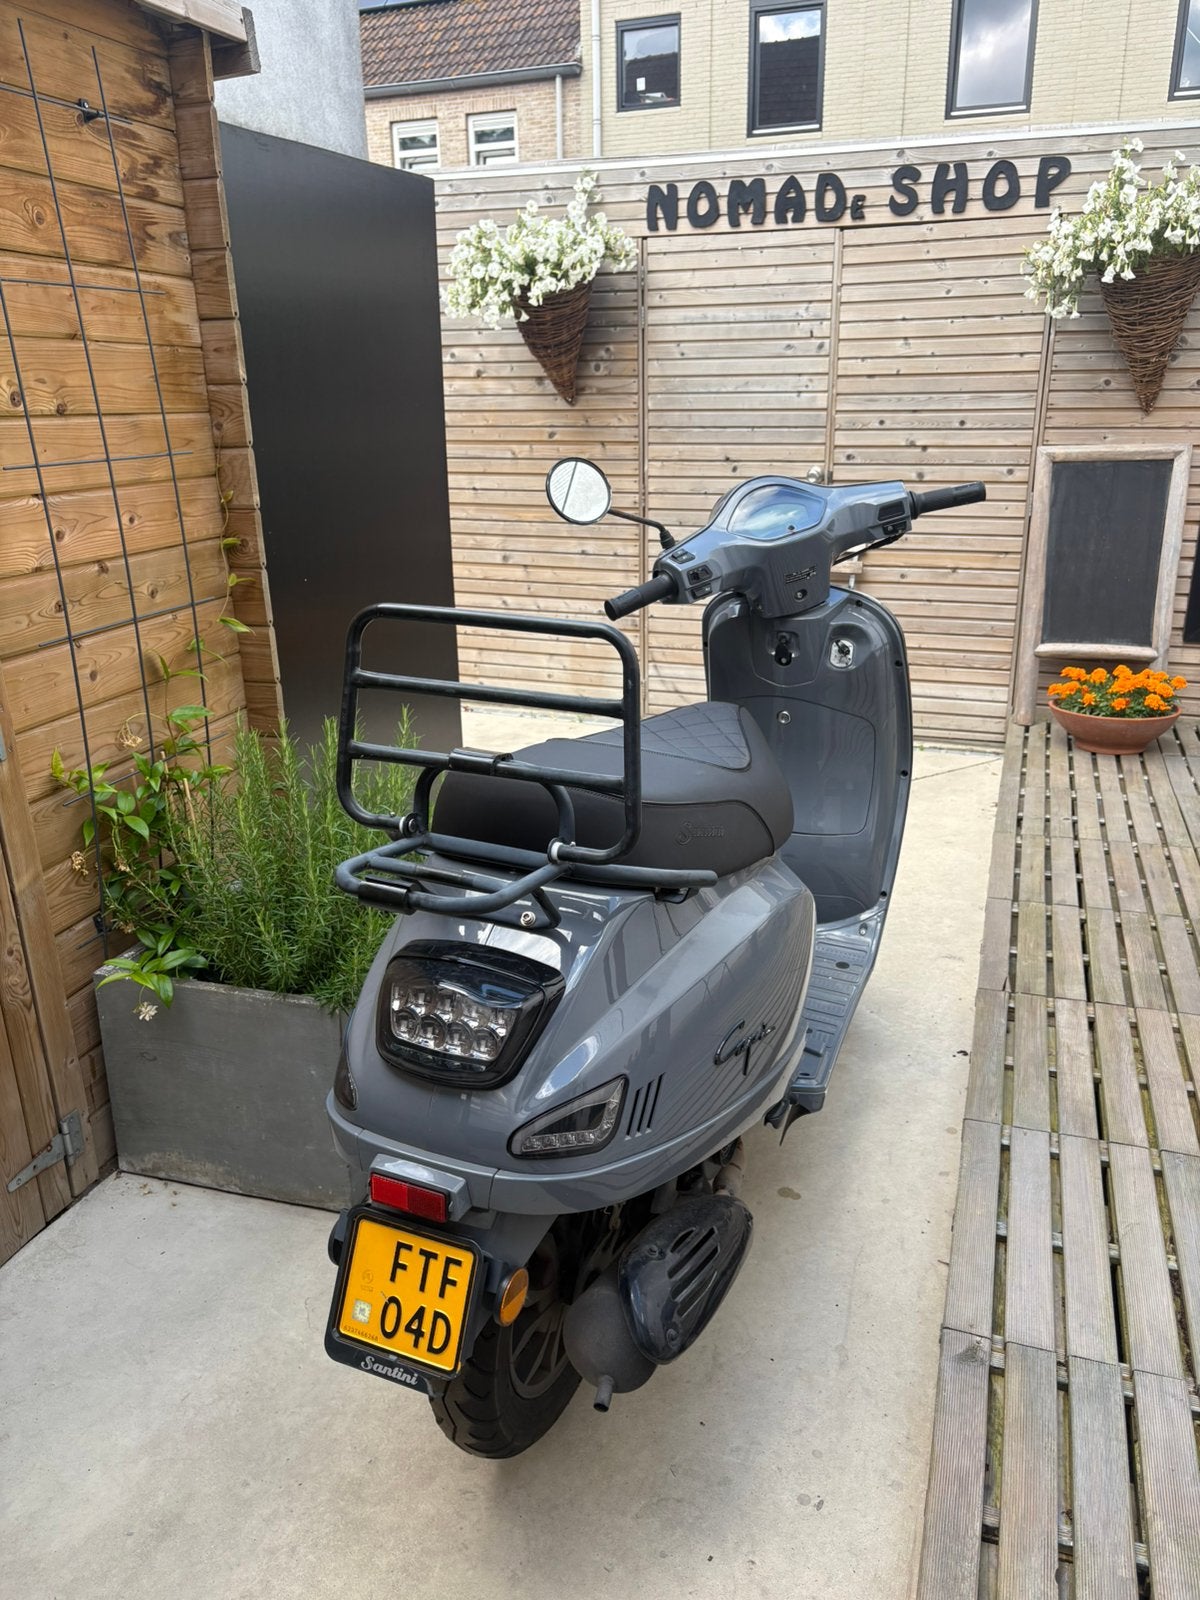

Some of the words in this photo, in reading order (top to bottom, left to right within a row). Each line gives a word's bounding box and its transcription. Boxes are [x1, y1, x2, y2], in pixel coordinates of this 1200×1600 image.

[888, 156, 1072, 217] SHOP
[389, 1240, 463, 1299] FTF
[380, 1295, 452, 1355] 04D
[360, 1355, 419, 1385] Santini
